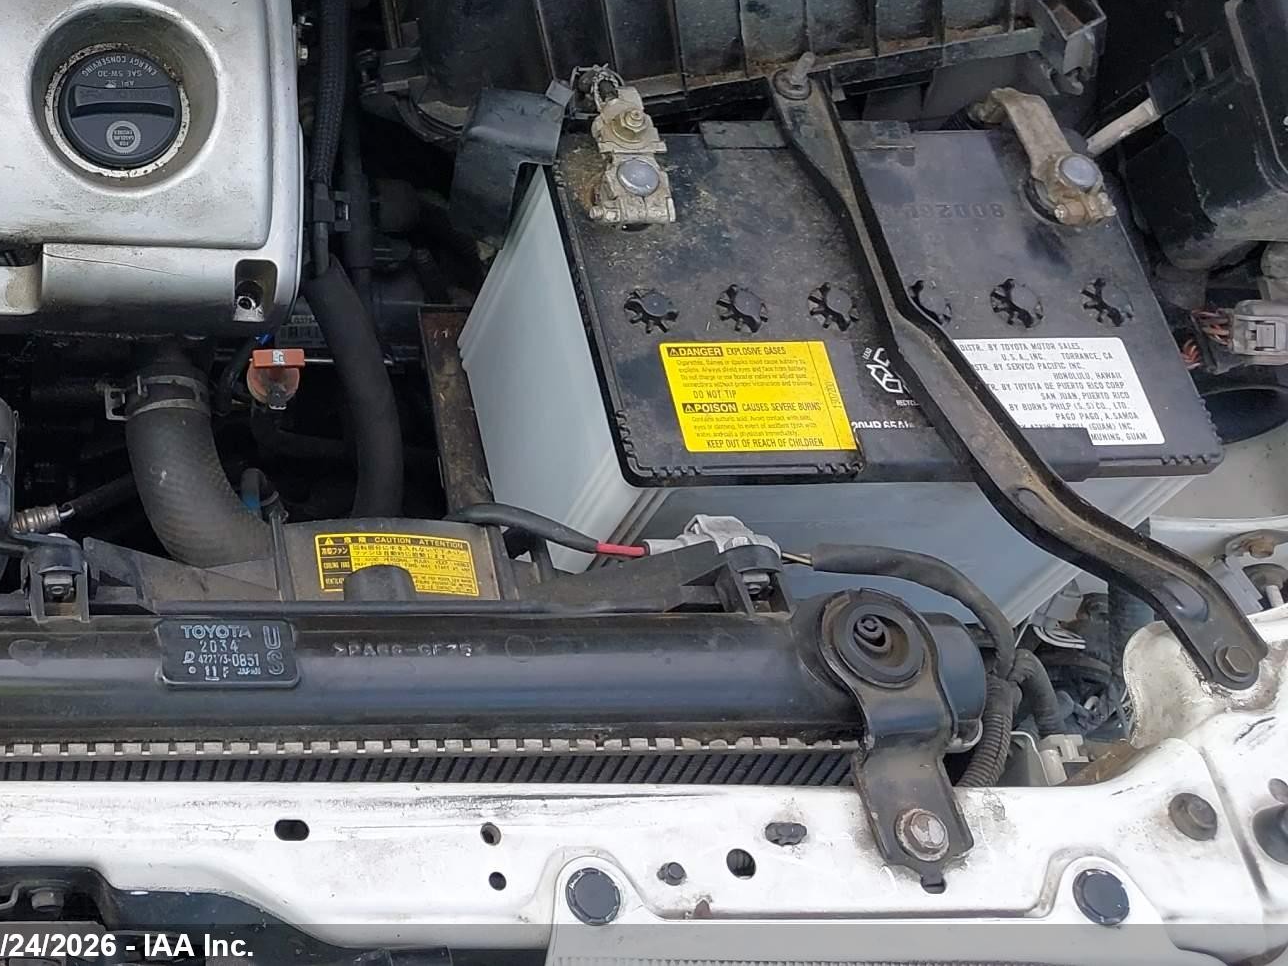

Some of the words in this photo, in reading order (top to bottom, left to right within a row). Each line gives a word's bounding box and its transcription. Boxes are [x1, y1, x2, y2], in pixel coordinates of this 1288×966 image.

[81, 55, 127, 77] CONSERVING
[129, 57, 158, 76] ENERGY
[679, 347, 722, 356] DANGER
[726, 347, 762, 355] EXPLOSIVE
[764, 347, 787, 355] GASES
[960, 344, 985, 352] DISTR.
[988, 343, 998, 351] BY
[1001, 343, 1029, 351] TOYOTA
[1031, 342, 1056, 350] MOTOR
[1062, 352, 1102, 361] TORRANCE,
[1103, 352, 1114, 360] CA
[994, 363, 1003, 371] BY
[1008, 363, 1035, 371] SERVCO
[1038, 362, 1066, 370] PACIFIC
[1053, 372, 1094, 381] HONOLULU,
[1096, 372, 1123, 380] HAWAII
[1002, 383, 1011, 391] BY
[1014, 383, 1042, 391] TOYOTA
[1044, 382, 1055, 390] DE
[1057, 382, 1084, 390] PUERTO
[1086, 382, 1105, 390] RICO
[693, 390, 704, 399] DO
[707, 390, 722, 399] NOT
[725, 390, 737, 399] TIP
[1041, 393, 1056, 401] SAN
[1082, 392, 1109, 400] PUERTO
[1112, 391, 1130, 400] RICO
[694, 403, 737, 413] POISON
[742, 403, 769, 412] CAUSES
[771, 402, 796, 411] SEVERE
[797, 402, 821, 411] BURNS
[1022, 403, 1048, 411] BURNS
[1056, 413, 1076, 421] PAGO
[1089, 422, 1116, 431] (GUAM)
[1091, 434, 1124, 442] MUNING,
[1126, 433, 1148, 441] GUAM
[707, 439, 724, 448] KEEP
[726, 439, 741, 448] OUT
[742, 438, 751, 448] OF
[752, 438, 776, 448] REACH
[778, 438, 787, 447] OF
[788, 438, 824, 447] CHILDREN
[375, 537, 411, 545] CAUTION
[419, 539, 463, 549] ATTENTION
[180, 624, 252, 640] TOYOTA
[200, 639, 239, 653] 2034
